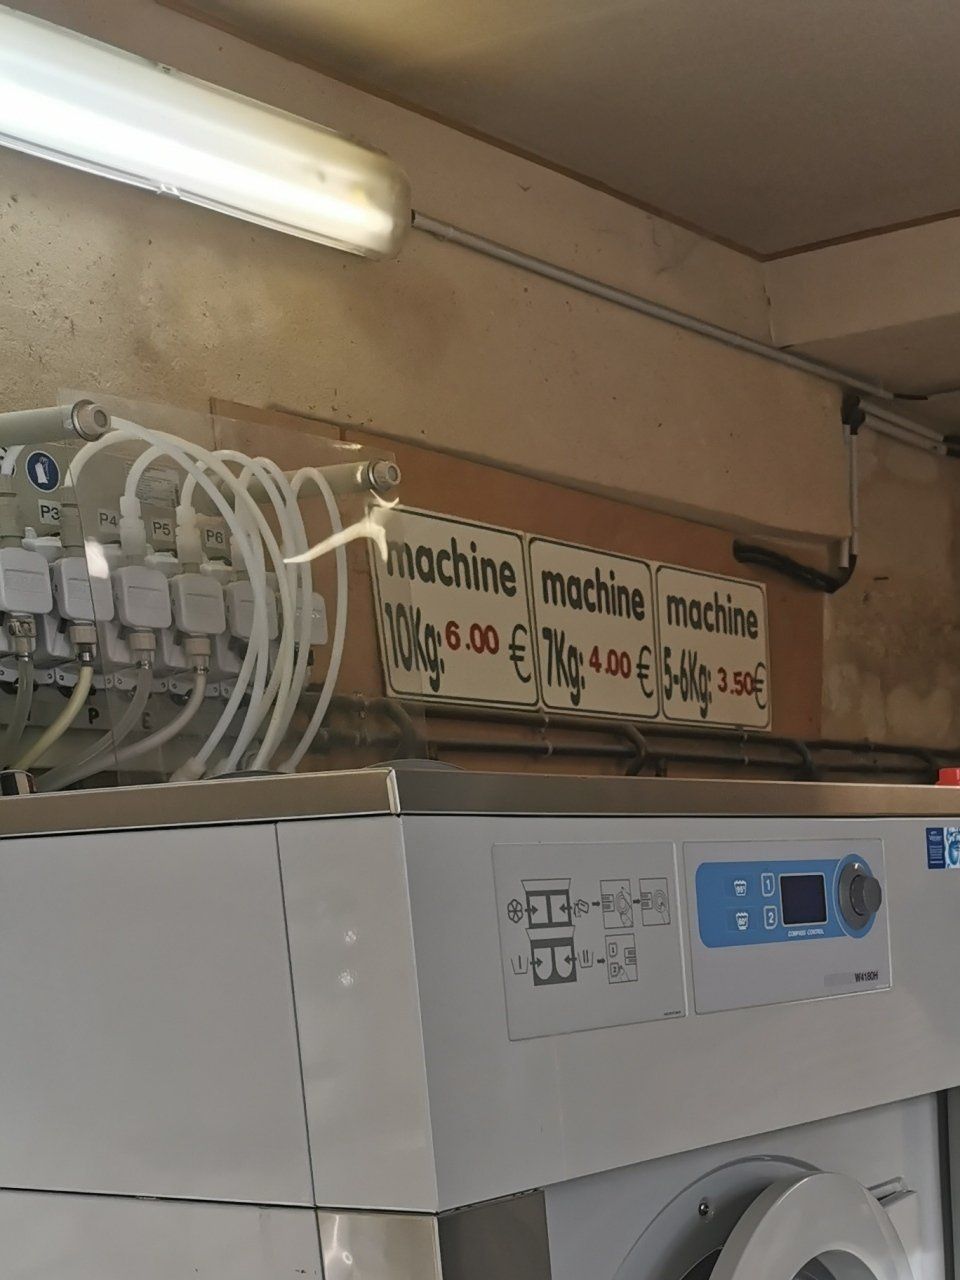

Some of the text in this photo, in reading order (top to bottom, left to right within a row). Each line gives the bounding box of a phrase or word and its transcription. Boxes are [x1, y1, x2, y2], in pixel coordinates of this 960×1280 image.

[40, 504, 60, 521] P3
[99, 512, 119, 528] P4
[152, 521, 171, 536] P5
[206, 528, 224, 544] P6
[387, 536, 517, 597] machine
[541, 566, 646, 621] machine
[666, 590, 760, 640] machine
[445, 620, 499, 655] 6.00
[508, 624, 532, 684] €
[589, 645, 632, 680] 4.00
[636, 645, 655, 699] €
[768, 911, 775, 924] 2
